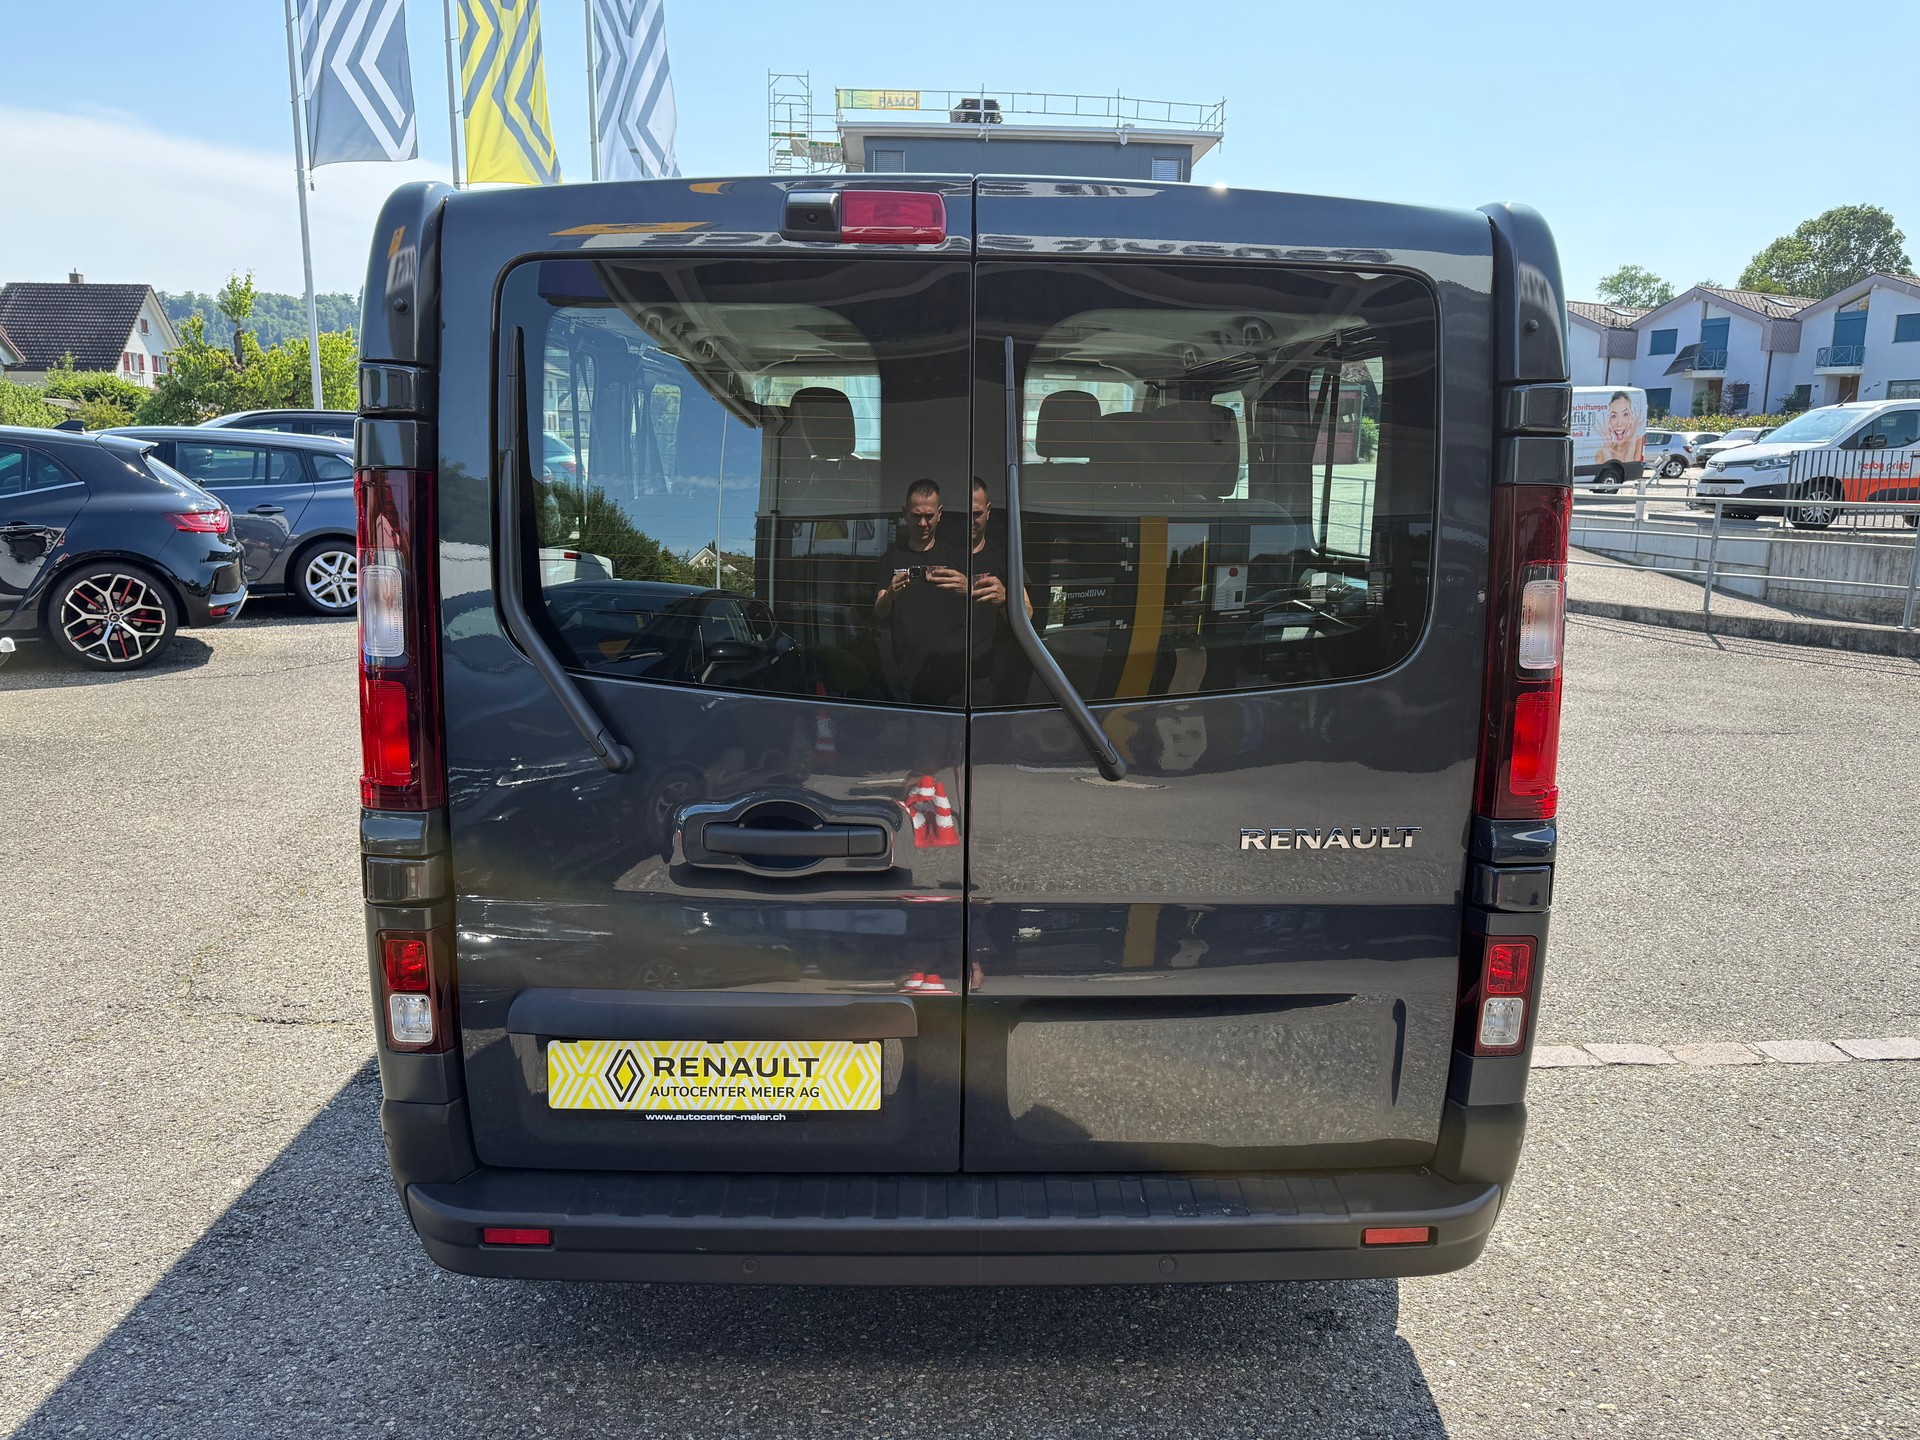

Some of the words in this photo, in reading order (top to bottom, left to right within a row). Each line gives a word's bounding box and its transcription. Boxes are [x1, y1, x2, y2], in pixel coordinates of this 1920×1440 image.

[1240, 827, 1422, 850] RENAULT
[653, 1057, 819, 1078] RENAULT
[650, 1086, 746, 1098] AUTOCENTER
[751, 1087, 795, 1098] MEIER
[799, 1087, 820, 1098] AG
[645, 1113, 786, 1121] www.autocenter-meier.ch
